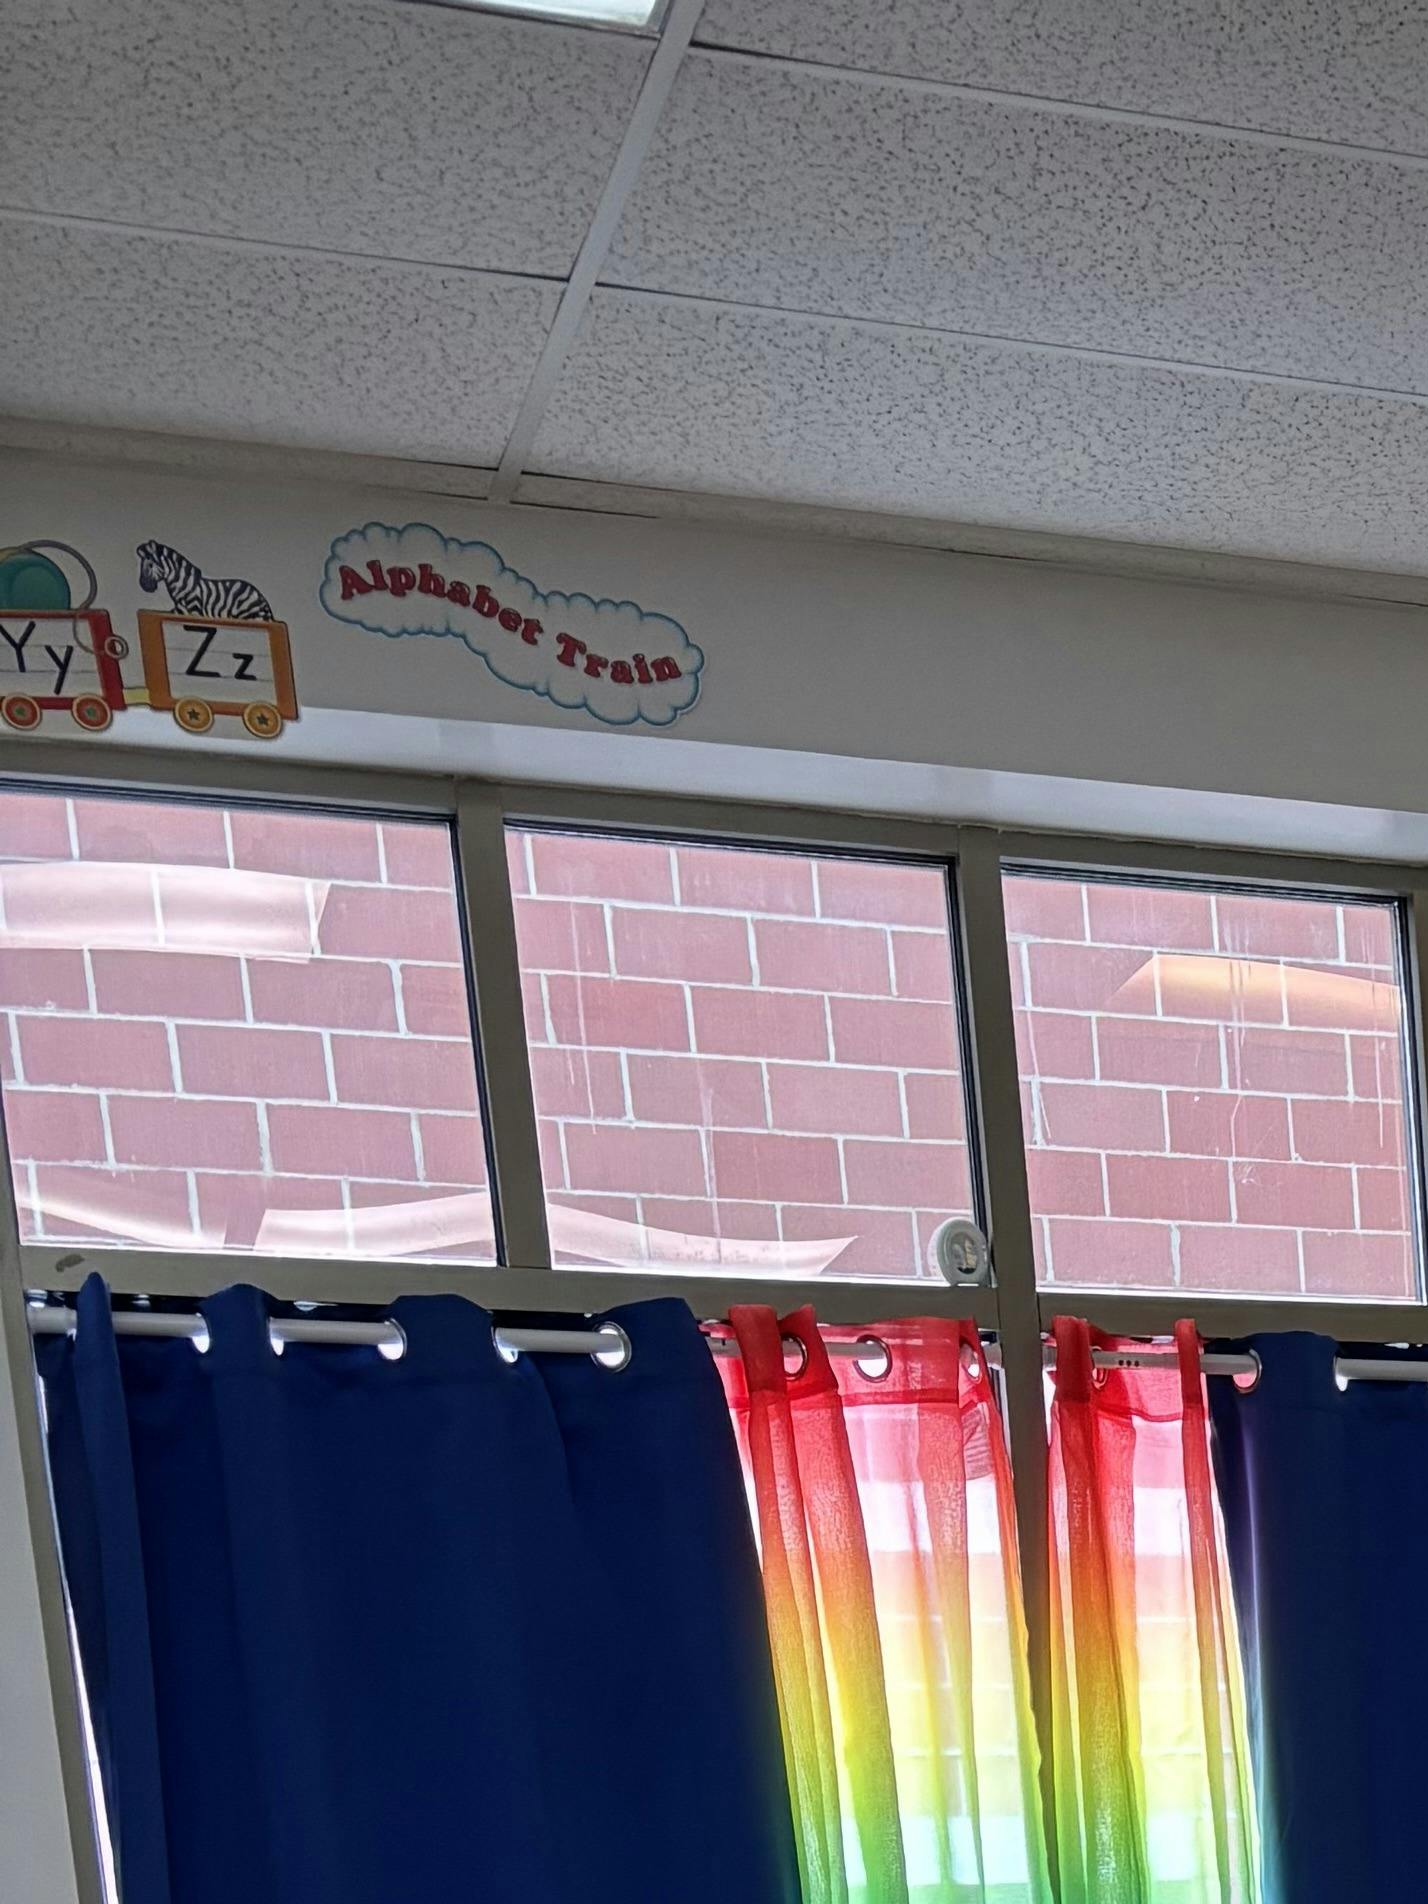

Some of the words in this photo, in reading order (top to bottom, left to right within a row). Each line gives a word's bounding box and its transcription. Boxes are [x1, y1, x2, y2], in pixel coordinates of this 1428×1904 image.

[183, 625, 257, 681] Zz
[338, 559, 545, 646] Alphabet
[556, 632, 682, 686] Train
